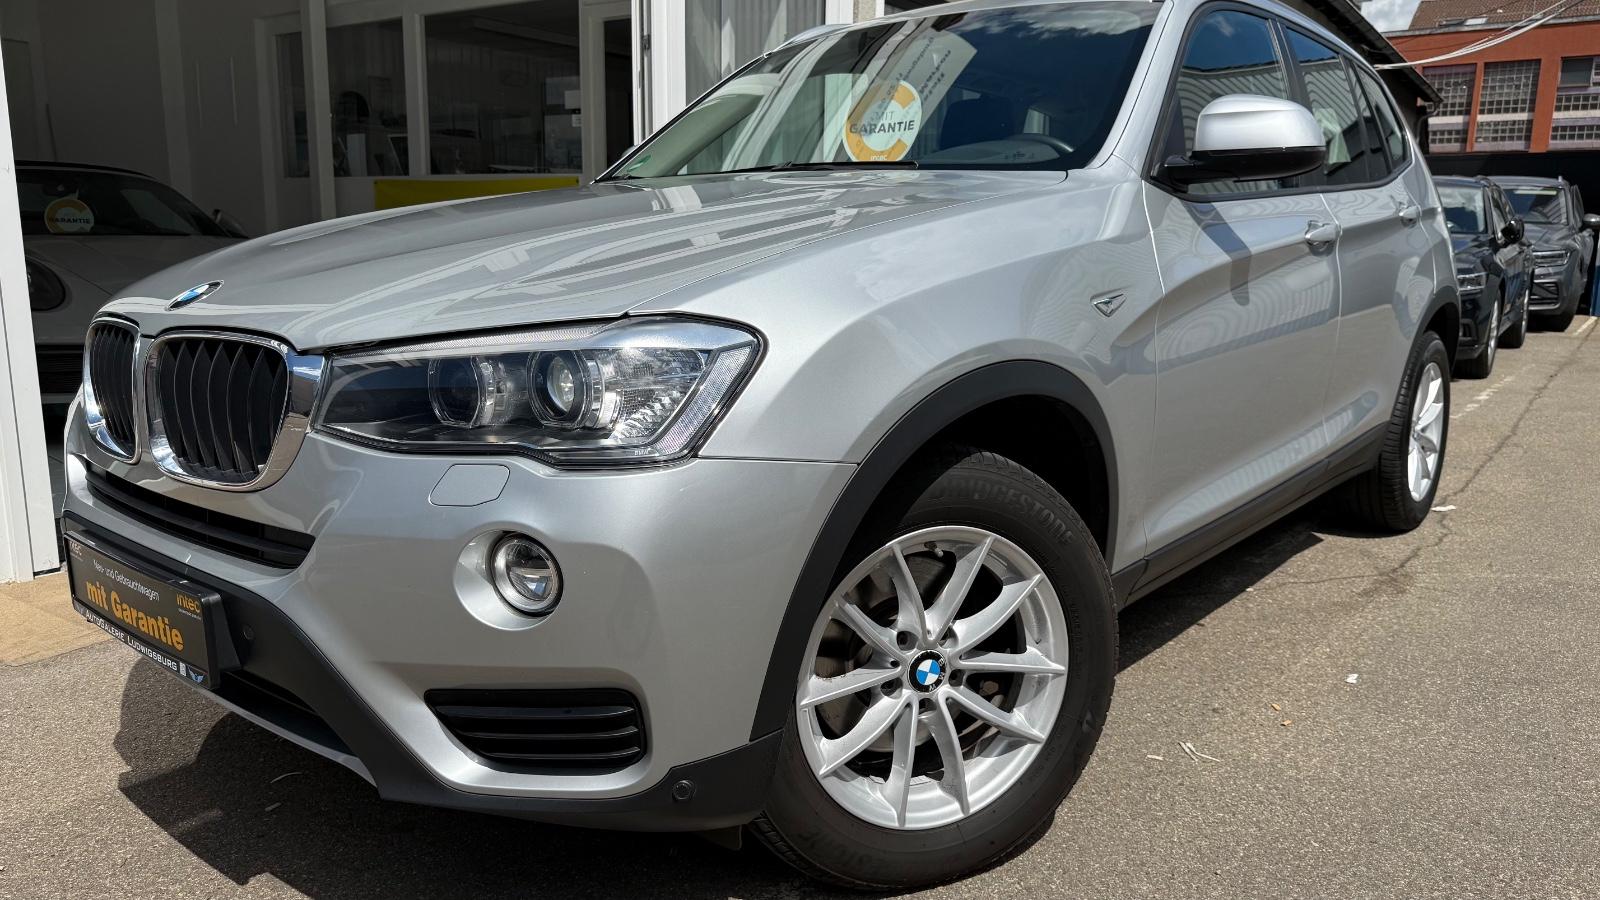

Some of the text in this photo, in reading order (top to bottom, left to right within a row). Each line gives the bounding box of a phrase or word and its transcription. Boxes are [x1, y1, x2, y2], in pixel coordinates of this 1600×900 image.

[849, 119, 916, 135] GARANTIE
[176, 593, 201, 615] intec
[86, 581, 184, 651] mit Garantie
